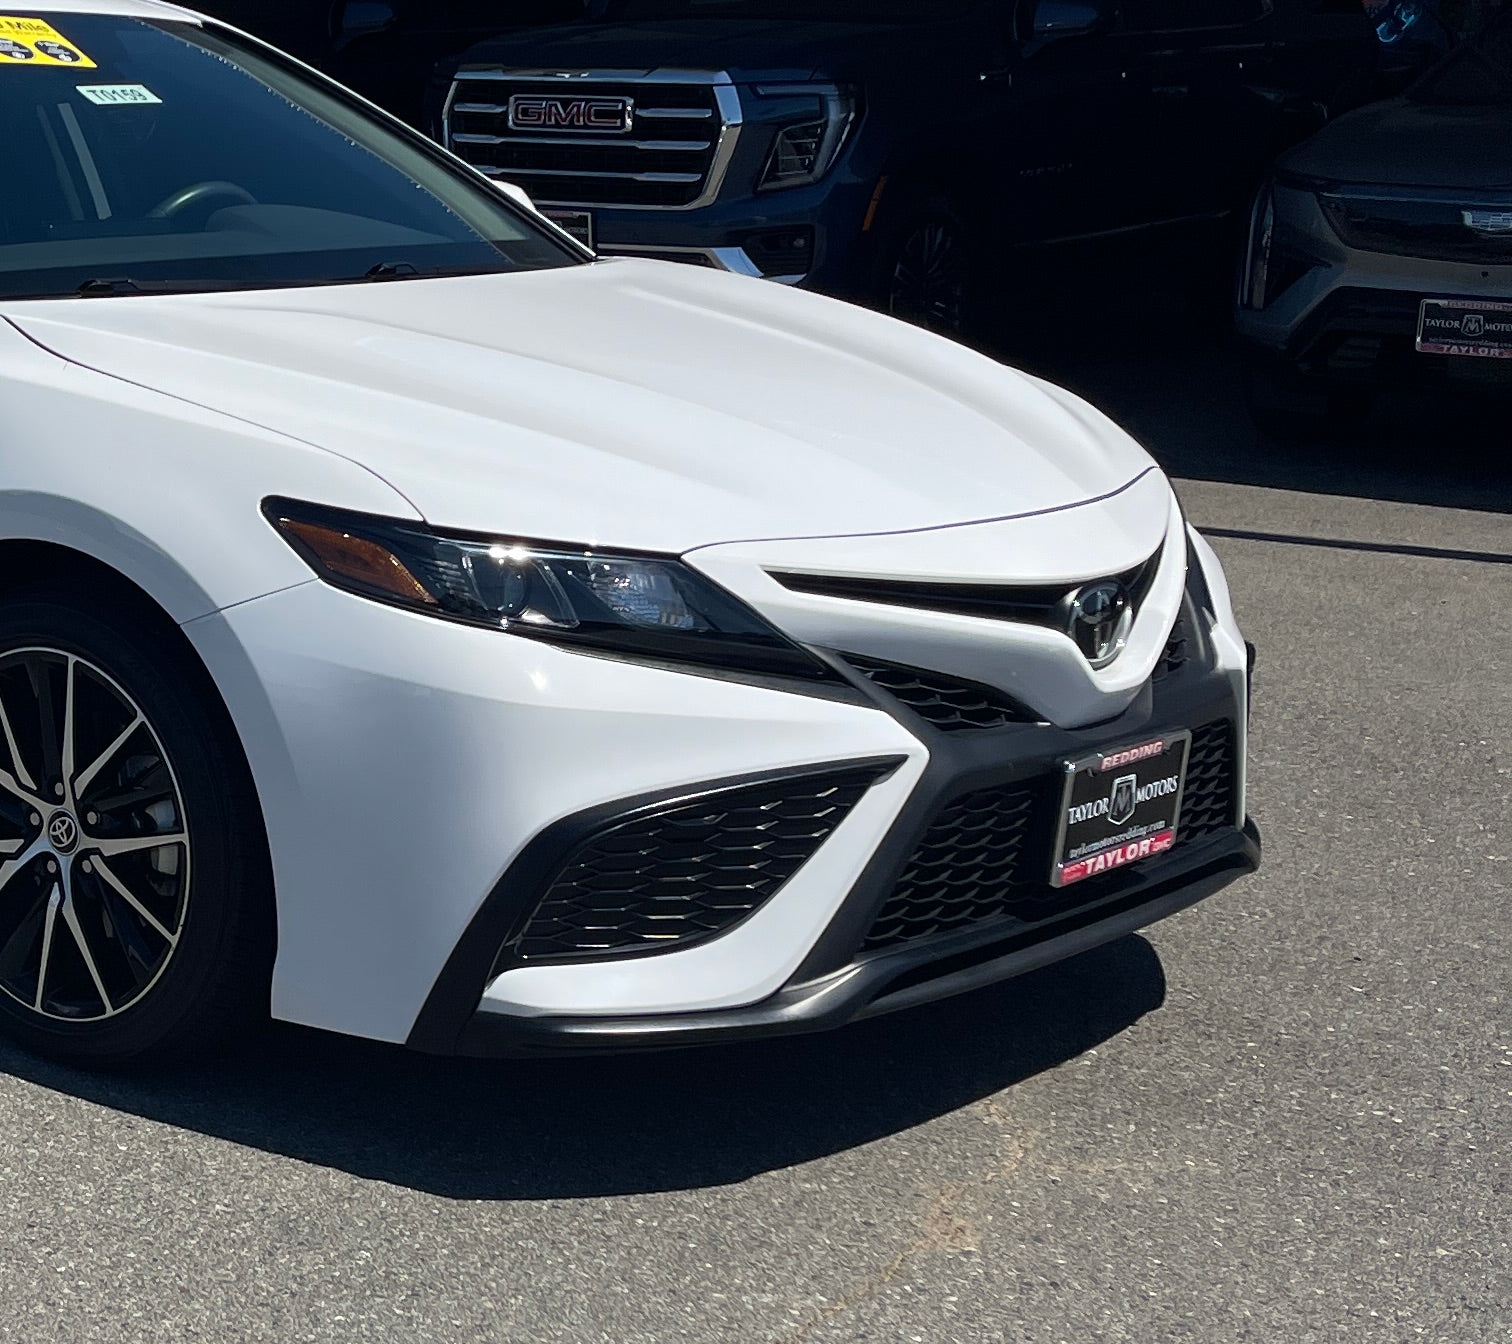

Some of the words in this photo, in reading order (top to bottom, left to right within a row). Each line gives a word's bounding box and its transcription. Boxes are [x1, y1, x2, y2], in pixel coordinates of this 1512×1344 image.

[8, 21, 50, 34] Mile
[514, 100, 622, 127] GMC
[1424, 318, 1460, 329] TAYLOR
[1484, 322, 1512, 332] MOTO
[1101, 741, 1163, 769] REDDING
[1068, 797, 1109, 824] TAYLOR
[1135, 775, 1179, 804] MOTORS
